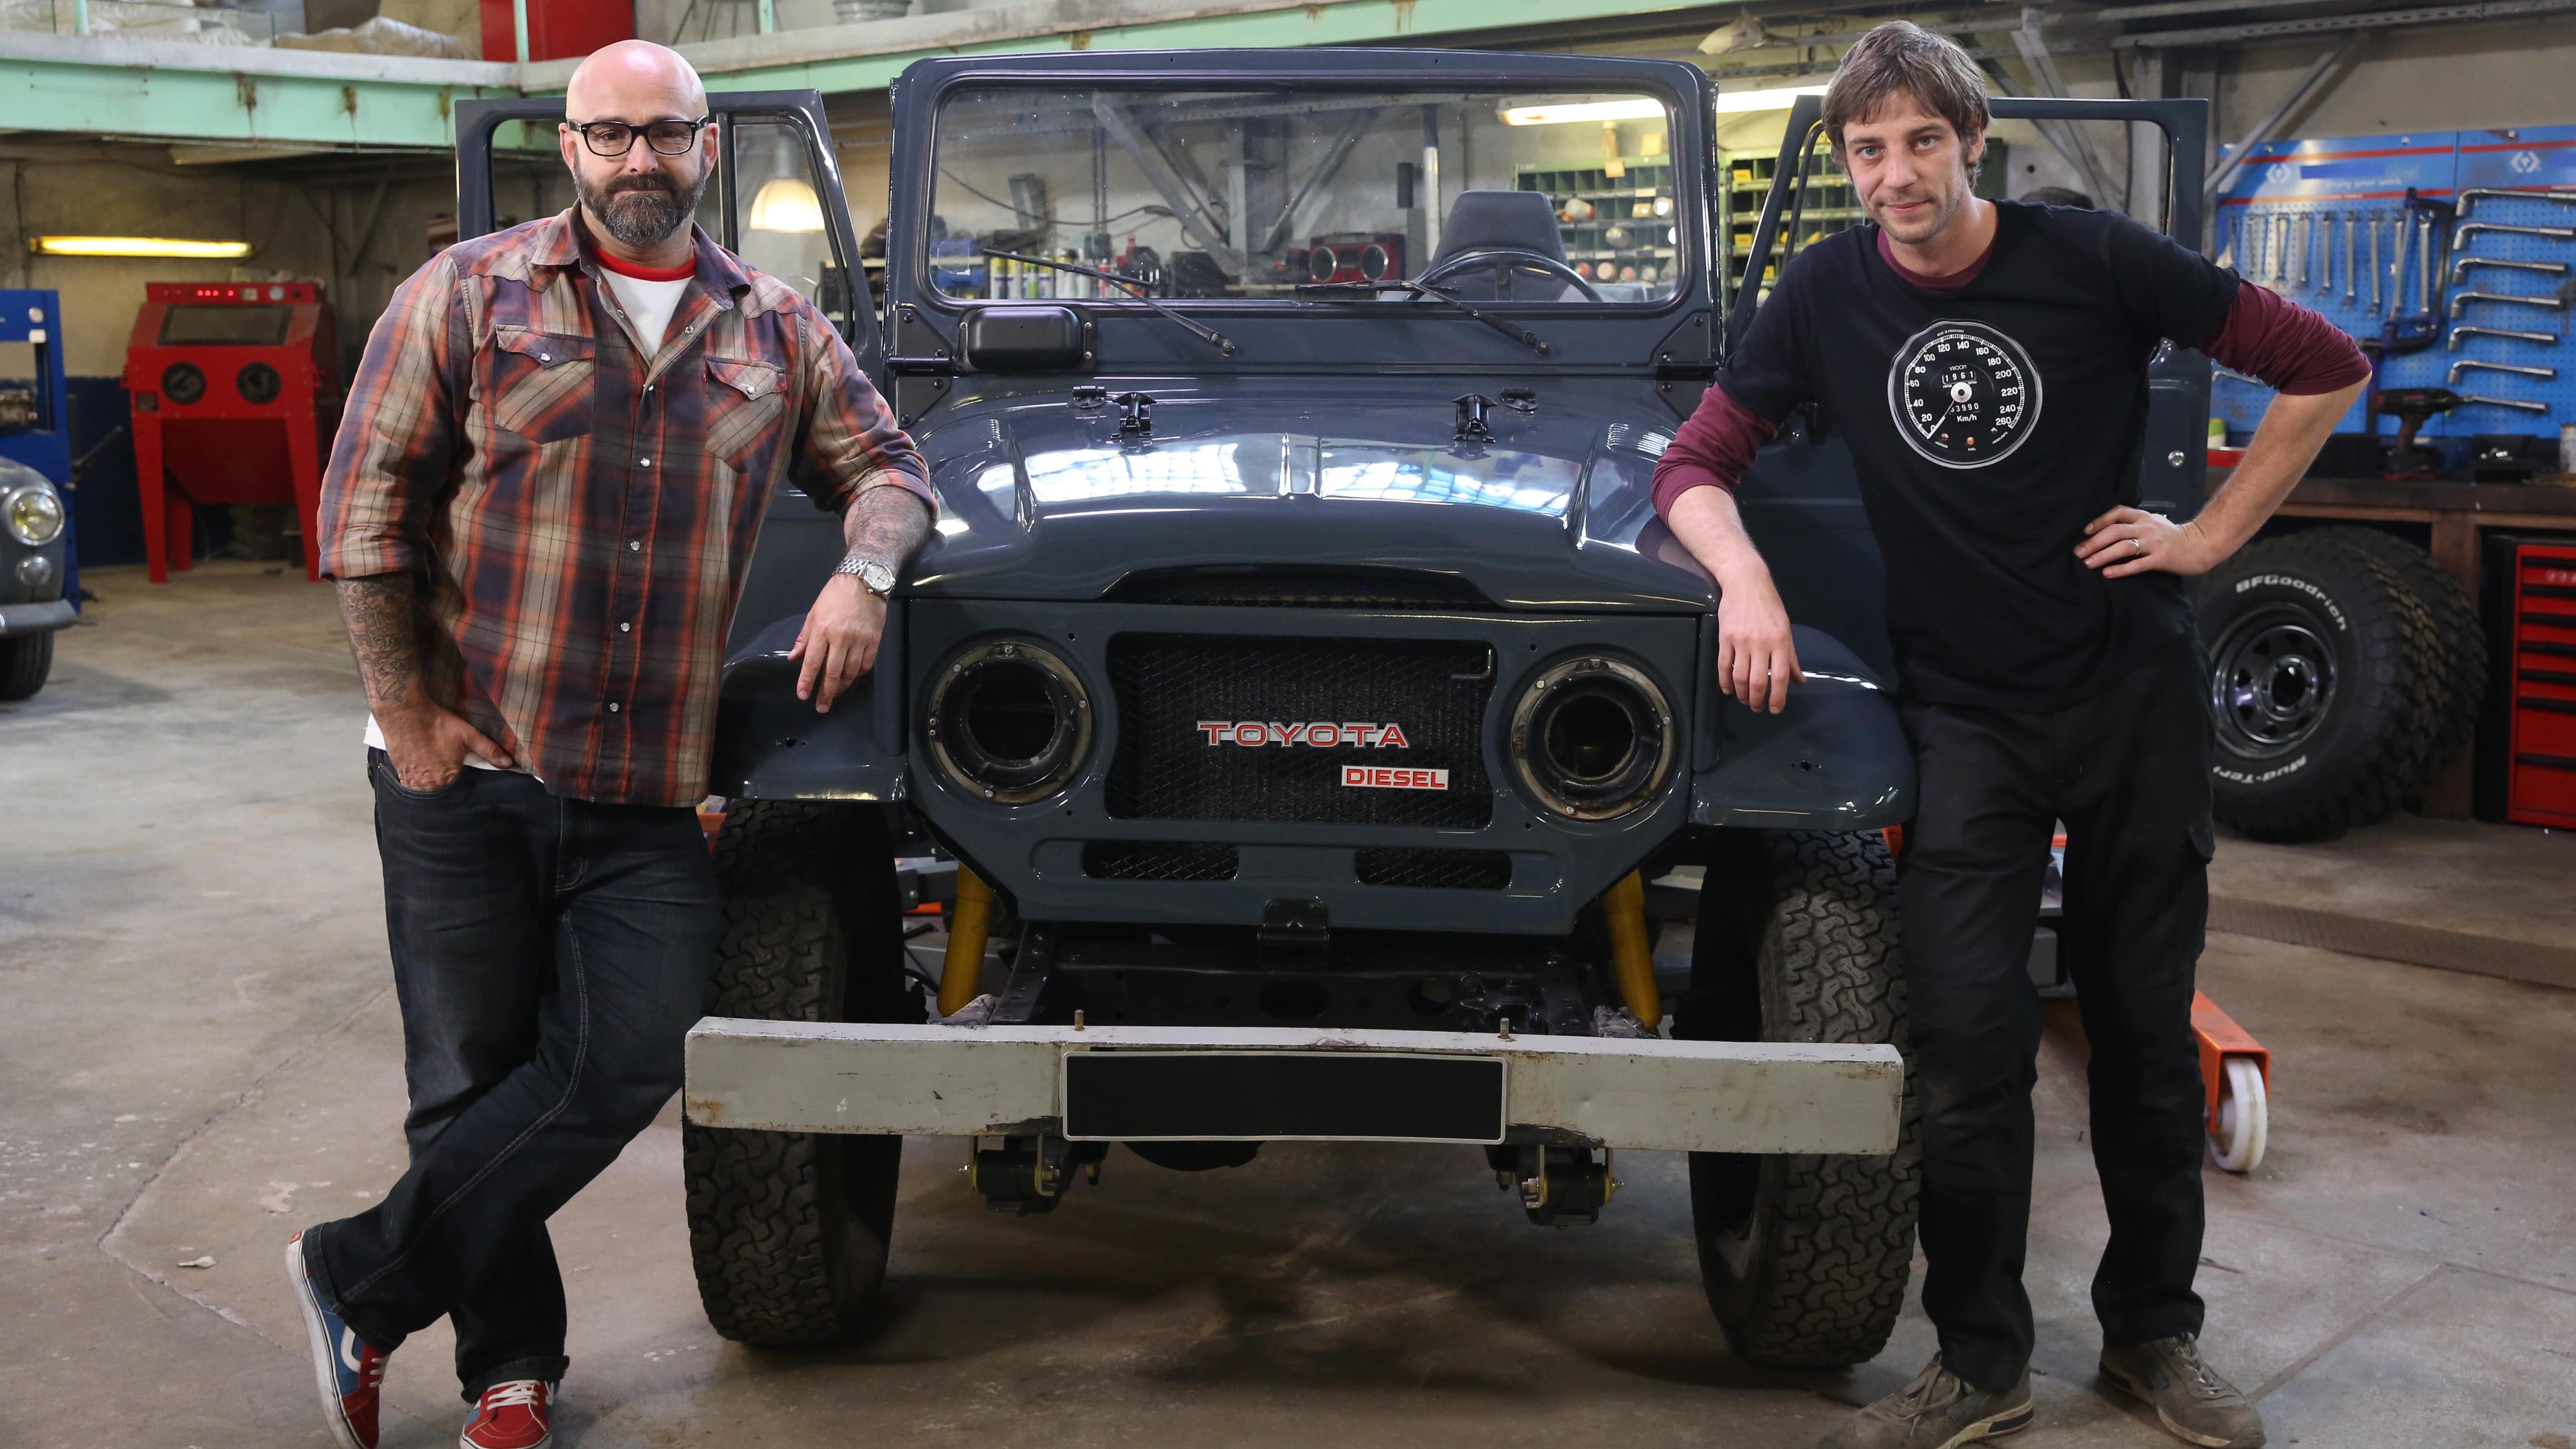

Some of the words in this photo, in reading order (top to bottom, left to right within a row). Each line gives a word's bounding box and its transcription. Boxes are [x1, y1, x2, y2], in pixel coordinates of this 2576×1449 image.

[1937, 343, 1950, 352] 120
[1957, 341, 1970, 350] 140
[1975, 347, 1989, 356] 160
[1924, 354, 1936, 362] 100
[1987, 357, 2001, 366] 180
[1995, 369, 2012, 379] 200
[2001, 387, 2018, 397] 220
[1913, 399, 1924, 407] 40
[2000, 404, 2016, 414] 240
[1921, 413, 1932, 422] 20
[1995, 417, 2012, 425] 260
[2236, 574, 2347, 631] BFGoodrich
[1197, 720, 1410, 748] TOYOTA
[1346, 768, 1445, 788] DIESEL
